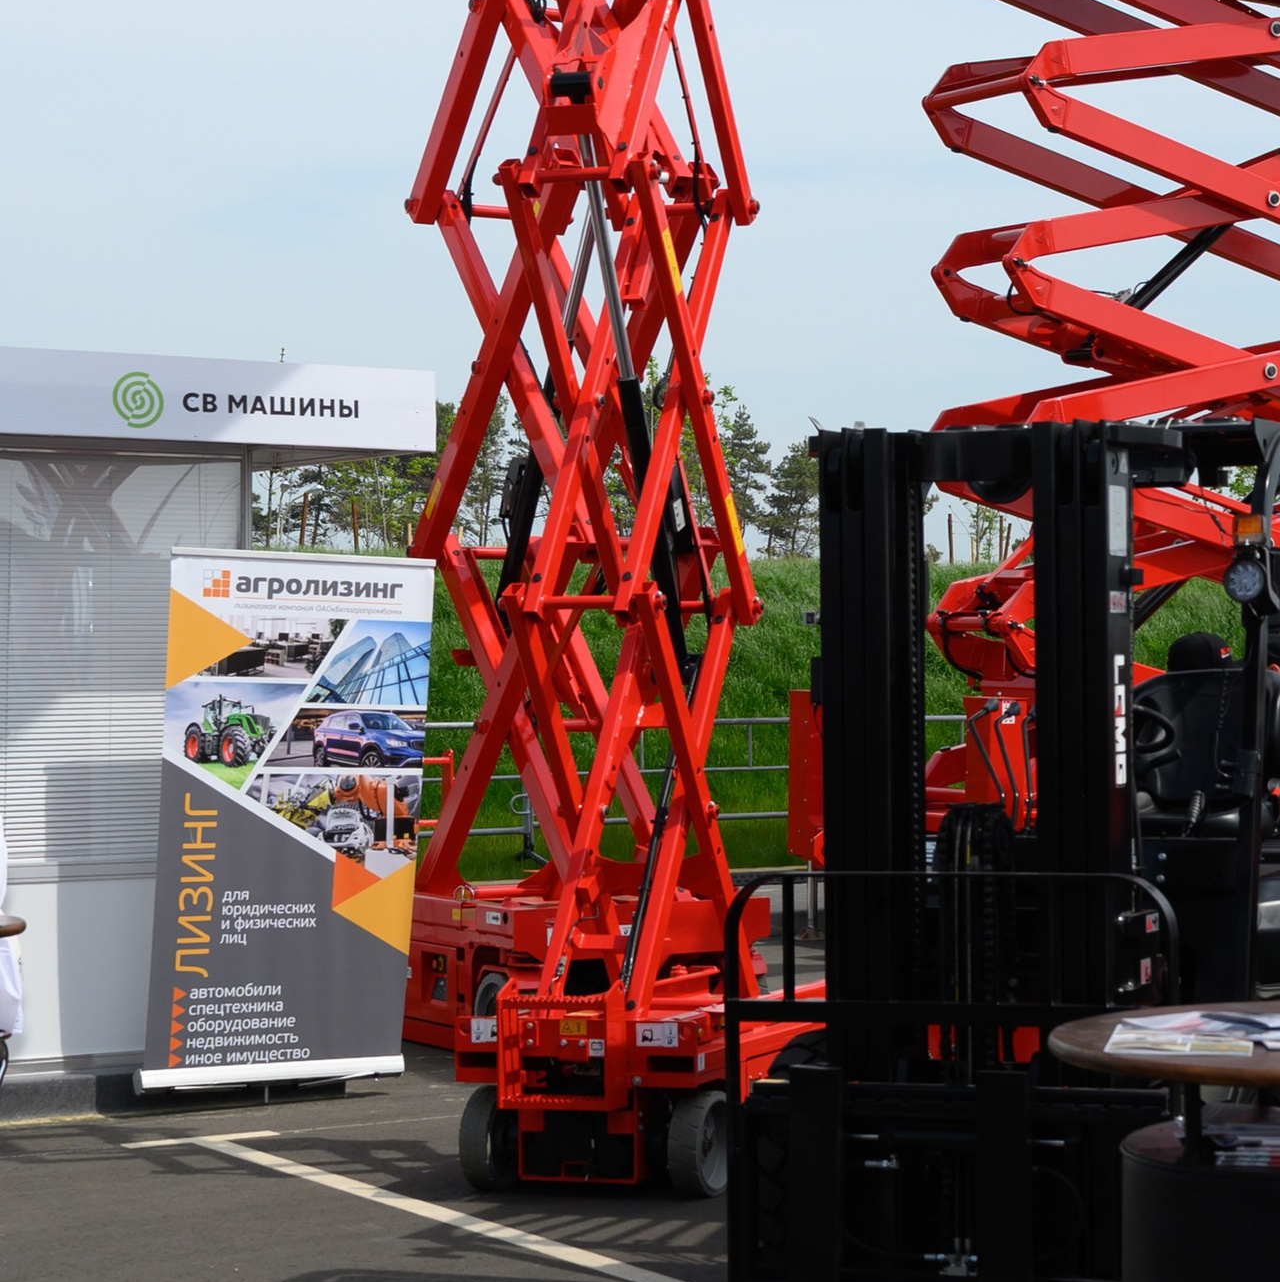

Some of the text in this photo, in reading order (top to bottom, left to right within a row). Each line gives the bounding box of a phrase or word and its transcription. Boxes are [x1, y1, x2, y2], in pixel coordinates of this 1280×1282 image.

[182, 392, 359, 419] СВ МАШИНЫ
[235, 575, 404, 600] агролизинг
[174, 792, 219, 978] ЛИЗИНГ
[222, 890, 250, 903] для
[221, 903, 316, 917] юридических
[220, 917, 317, 932] и физических
[219, 933, 247, 946] лиц
[189, 983, 282, 1000] автомобили
[188, 1000, 284, 1016] спецтехника
[187, 1016, 296, 1034] оборудование
[186, 1032, 299, 1050] недвижимость
[185, 1047, 310, 1066] иное имущество
